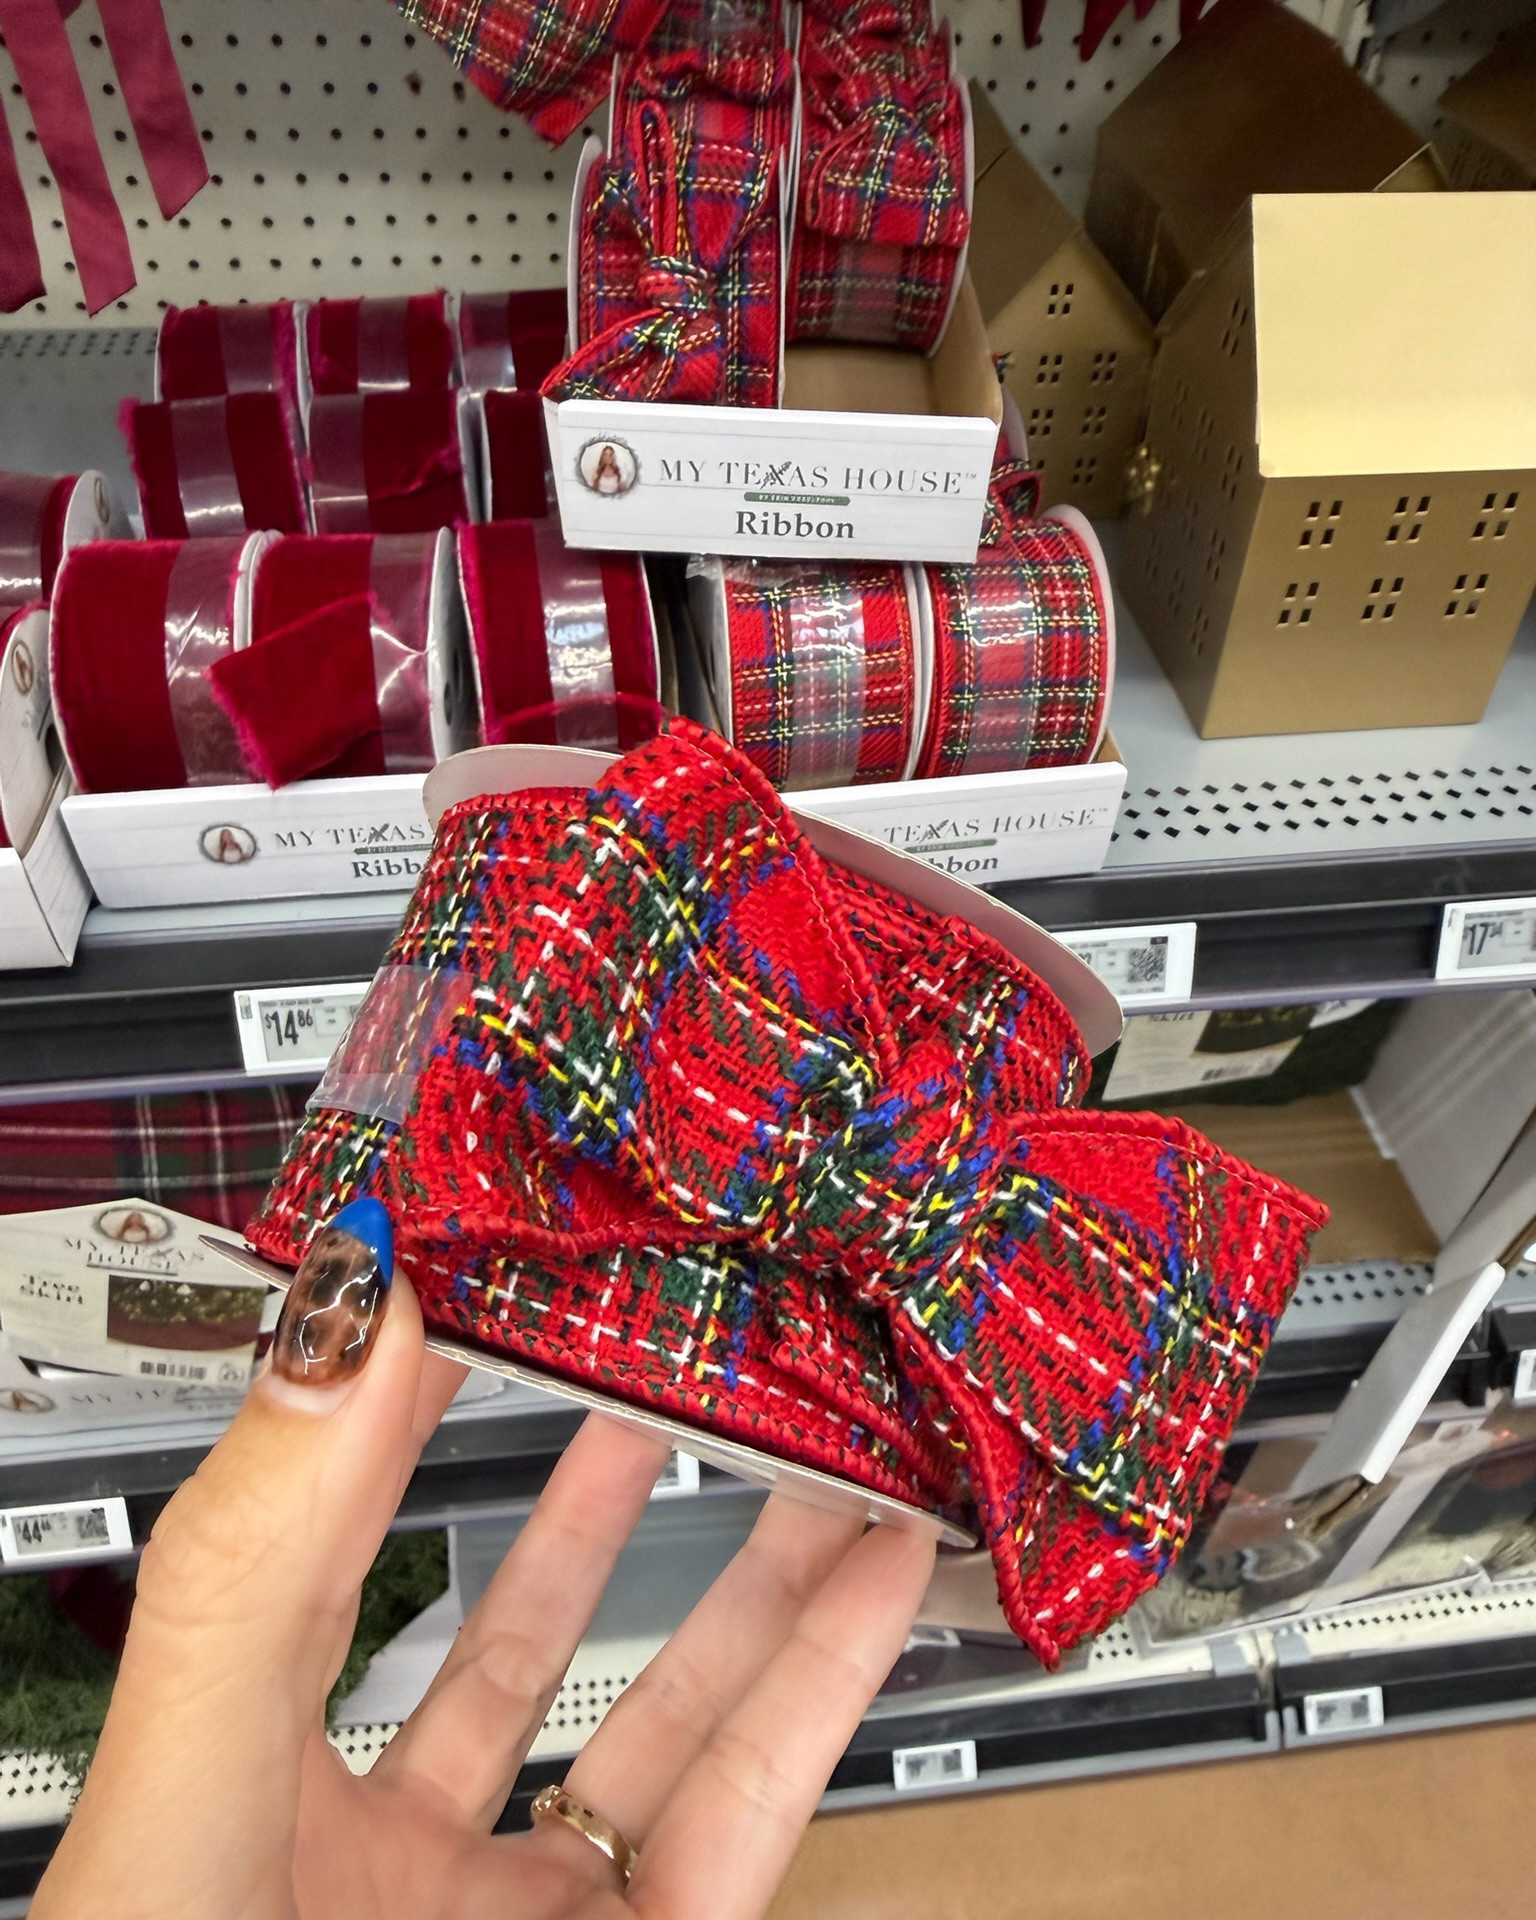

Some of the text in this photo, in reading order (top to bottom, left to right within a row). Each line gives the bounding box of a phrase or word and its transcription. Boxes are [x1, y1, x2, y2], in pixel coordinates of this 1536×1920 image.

[660, 459, 706, 482] MY
[719, 461, 828, 489] TEXAS
[735, 510, 855, 539] Ribbon
[275, 823, 425, 847] MY TEXAS
[884, 818, 980, 843] TEXAS
[352, 858, 421, 878] Ribb
